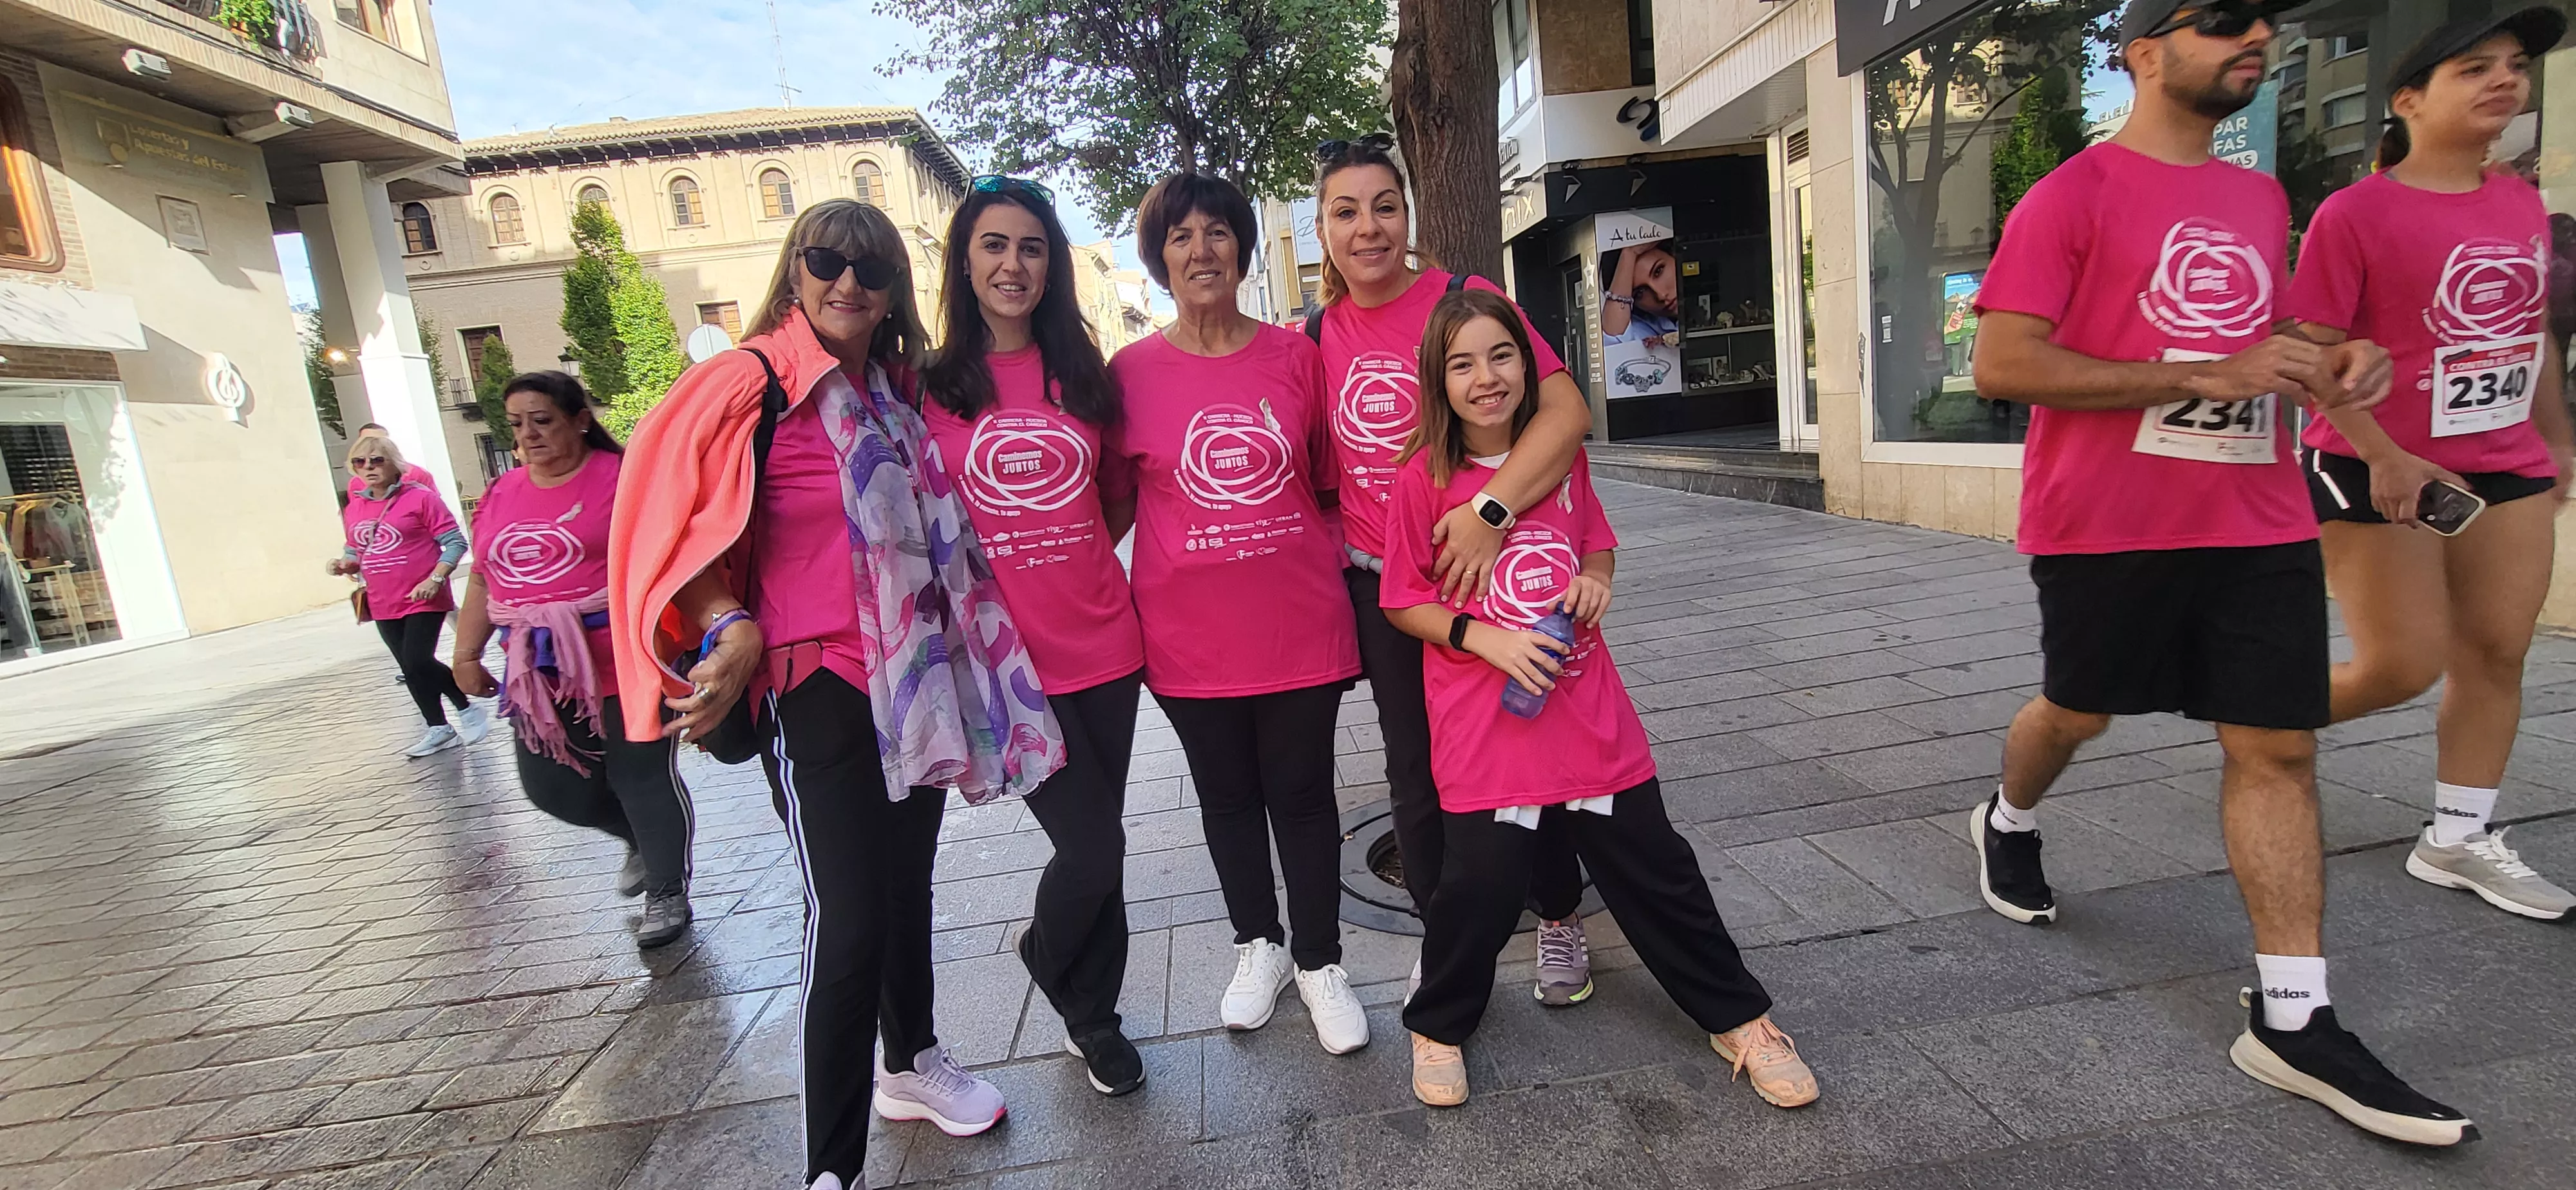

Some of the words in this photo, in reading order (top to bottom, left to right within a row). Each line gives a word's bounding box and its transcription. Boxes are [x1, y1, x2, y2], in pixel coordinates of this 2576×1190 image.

[1609, 228, 1624, 248] A
[1625, 227, 1637, 241] tu
[1639, 224, 1662, 240] lado
[2447, 366, 2527, 410] 2340
[1363, 402, 1395, 413] JUNTOS
[1003, 459, 1041, 475] JUNTOS
[1214, 455, 1249, 470] JUNTOS
[1520, 575, 1553, 592] JUNTOS
[2264, 987, 2311, 999] adidas
